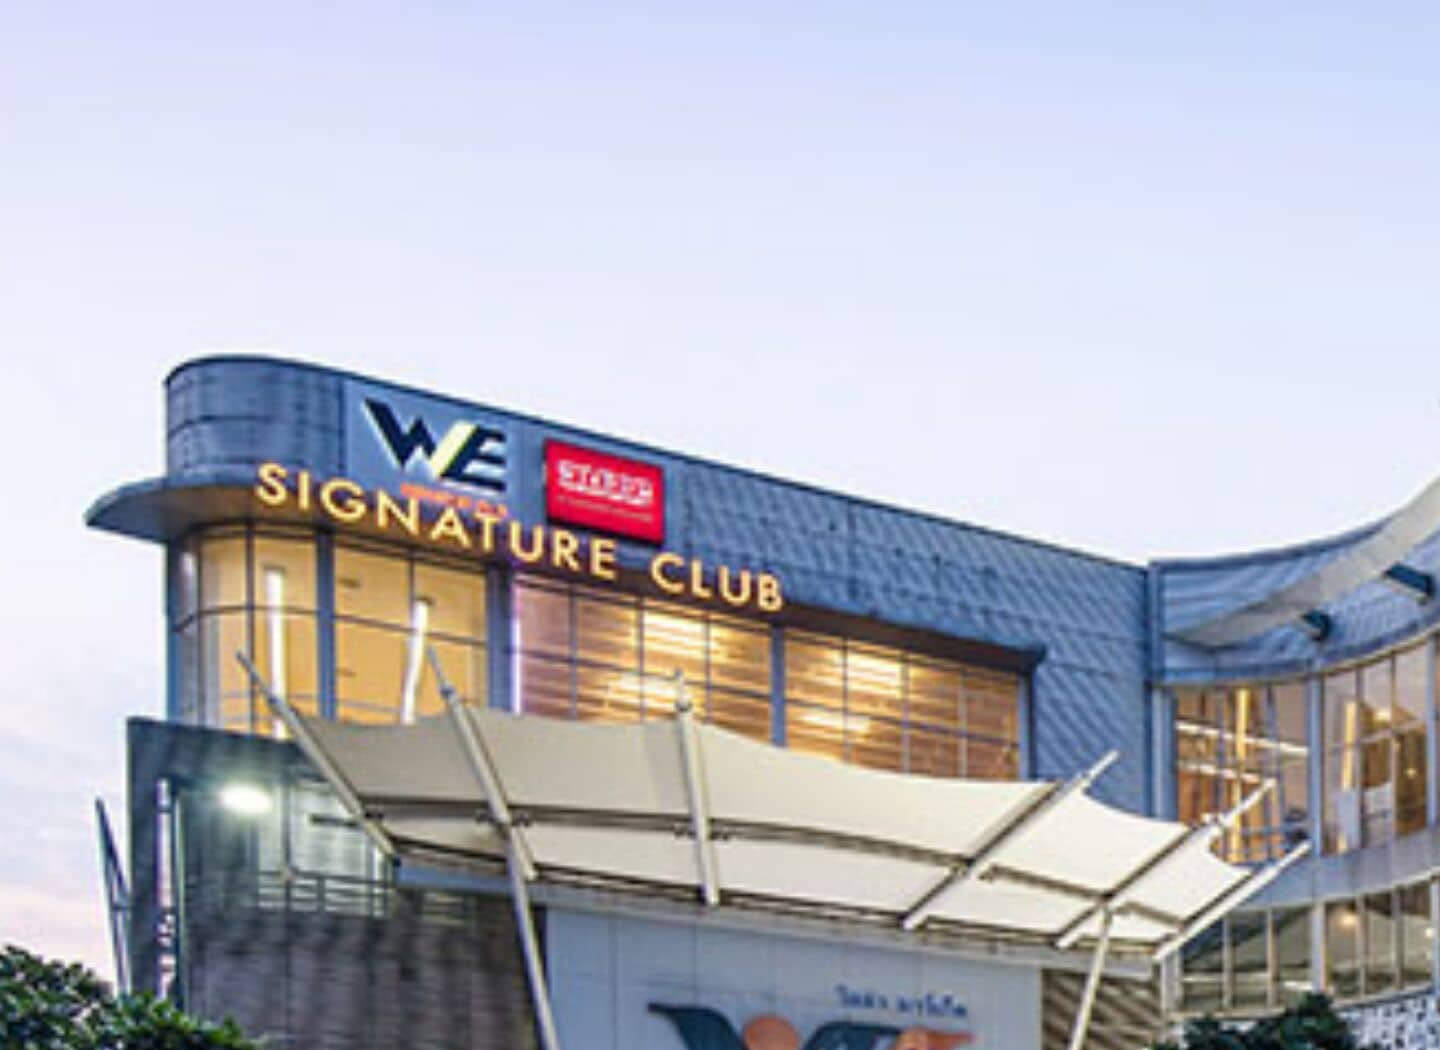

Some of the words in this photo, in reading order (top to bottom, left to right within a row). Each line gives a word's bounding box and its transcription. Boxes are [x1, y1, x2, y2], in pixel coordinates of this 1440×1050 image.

[364, 398, 507, 492] WE
[254, 461, 618, 580] SIGNATURE
[650, 551, 785, 611] CLUB
